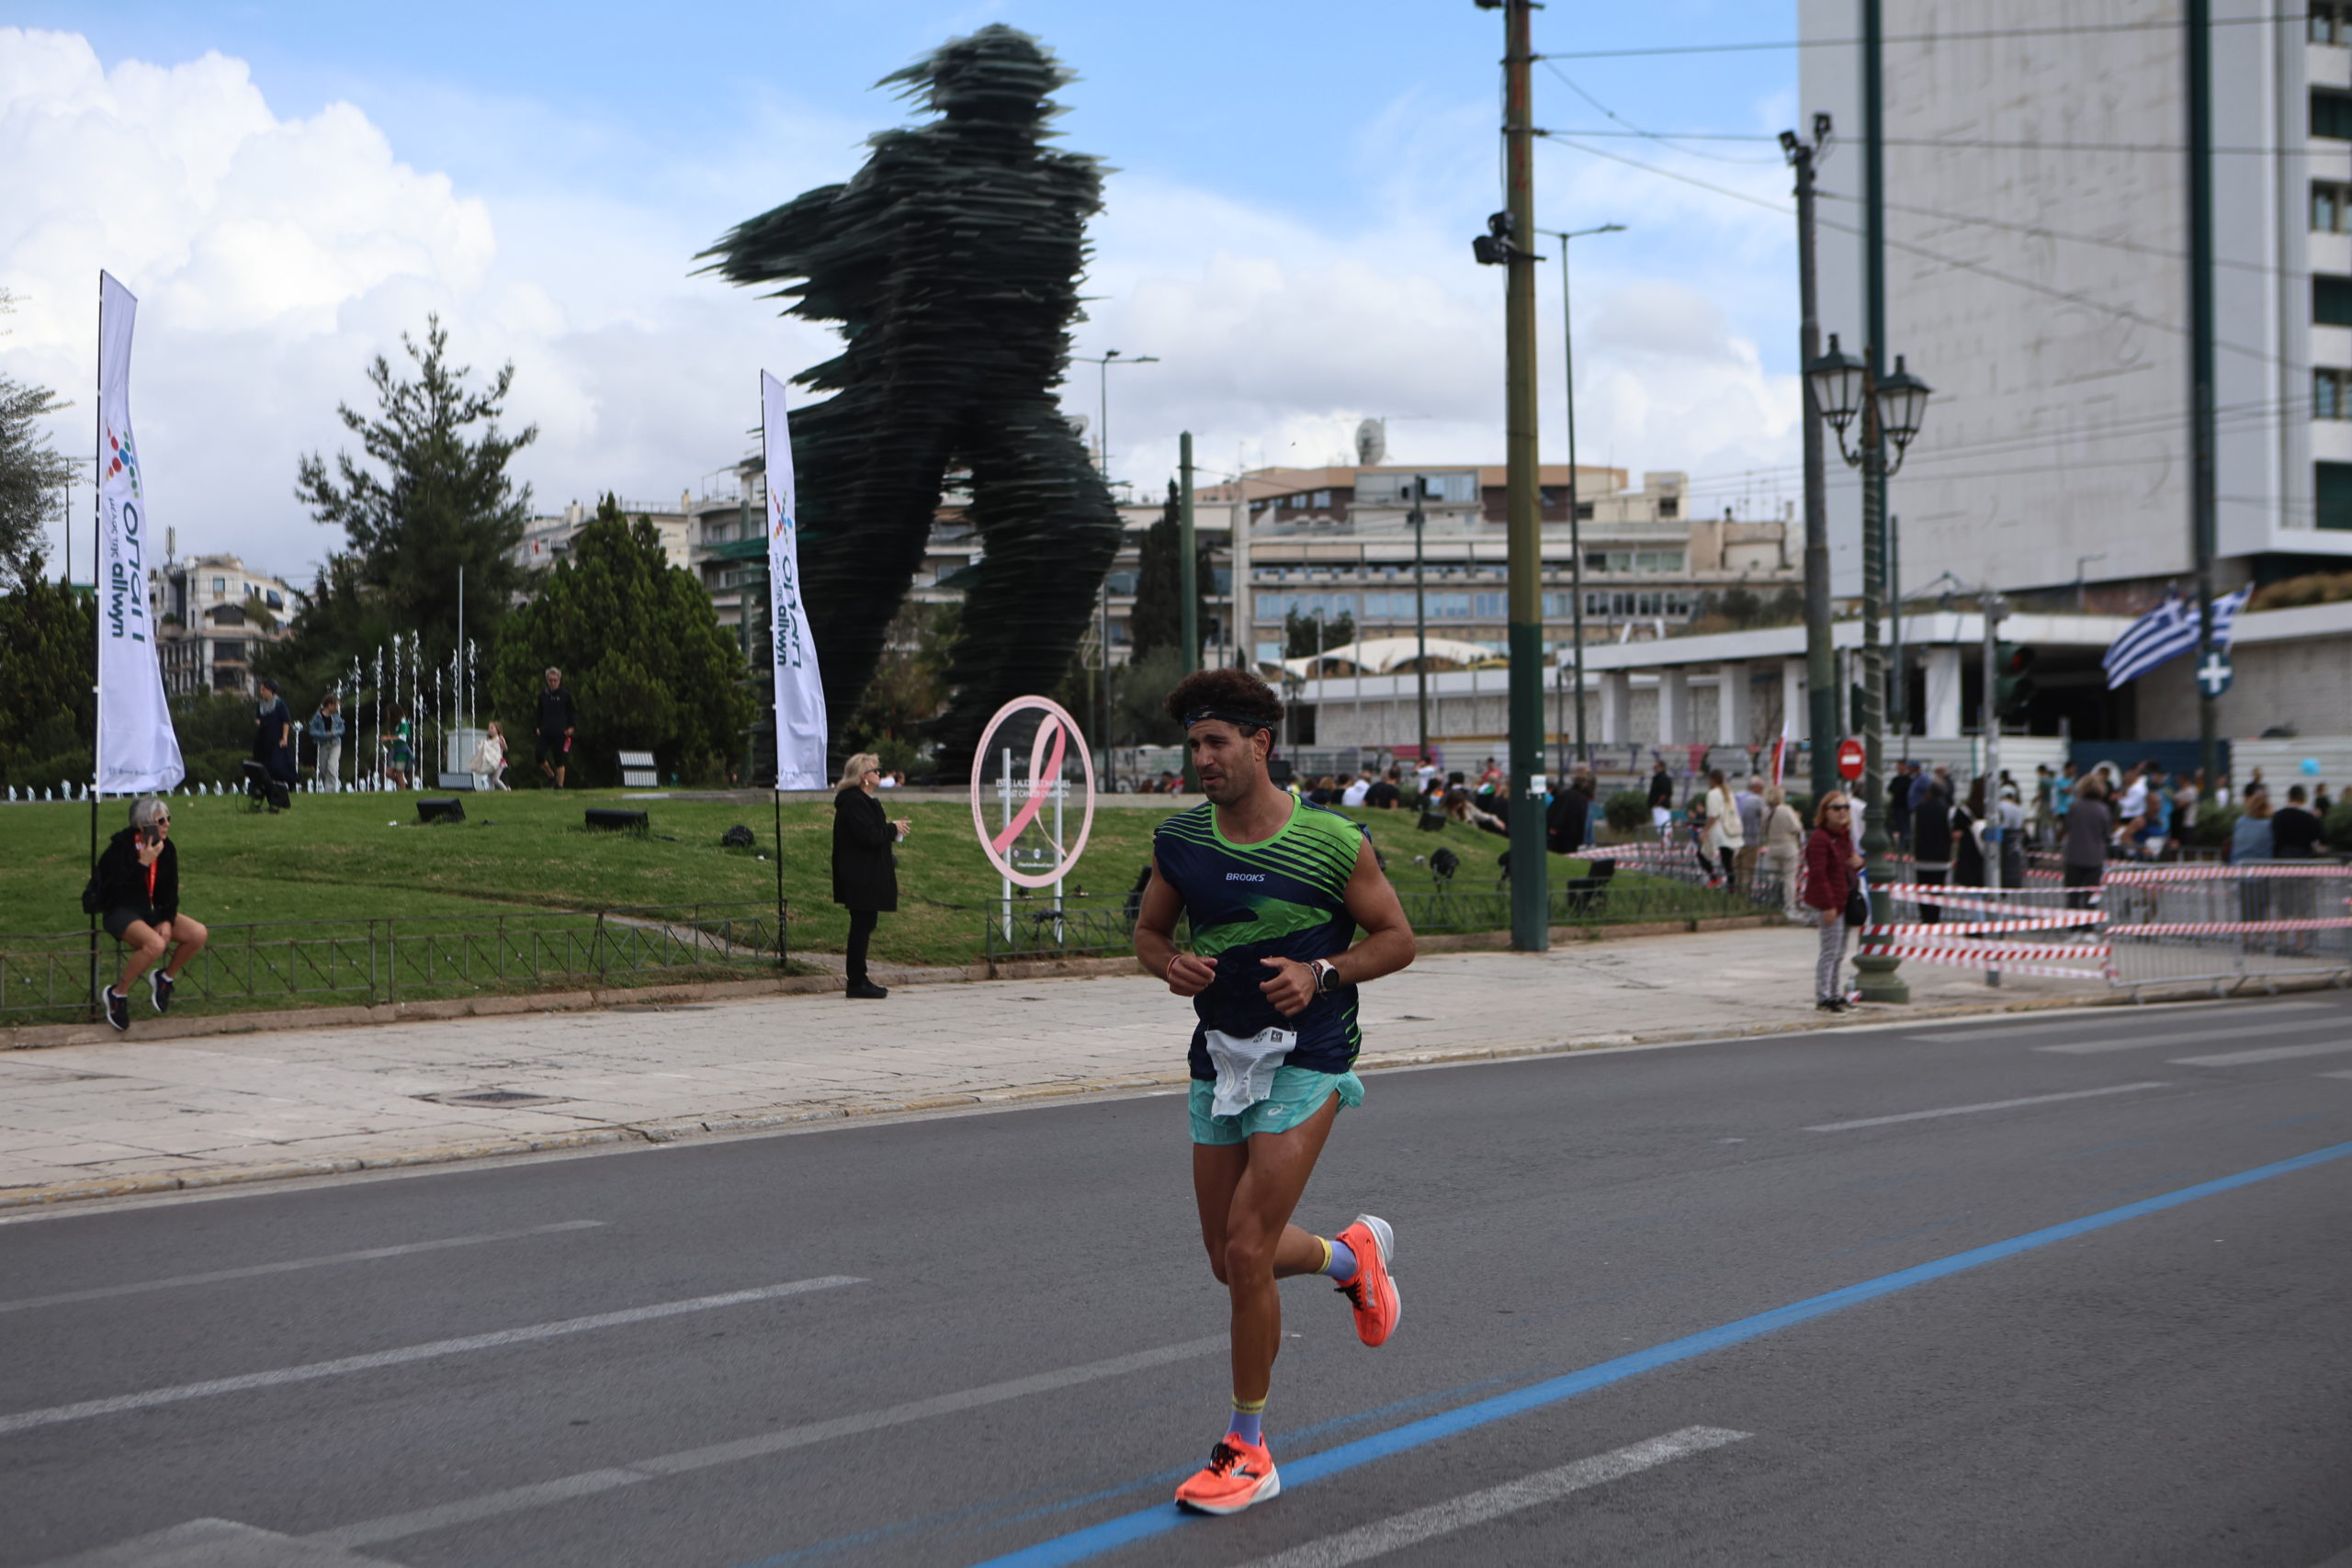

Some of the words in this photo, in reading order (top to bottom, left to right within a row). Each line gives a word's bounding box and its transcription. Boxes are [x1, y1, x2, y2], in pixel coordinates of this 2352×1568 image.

[108, 562, 129, 638] allwyn
[776, 604, 790, 666] allwyn
[1226, 873, 1265, 882] BROOKS
